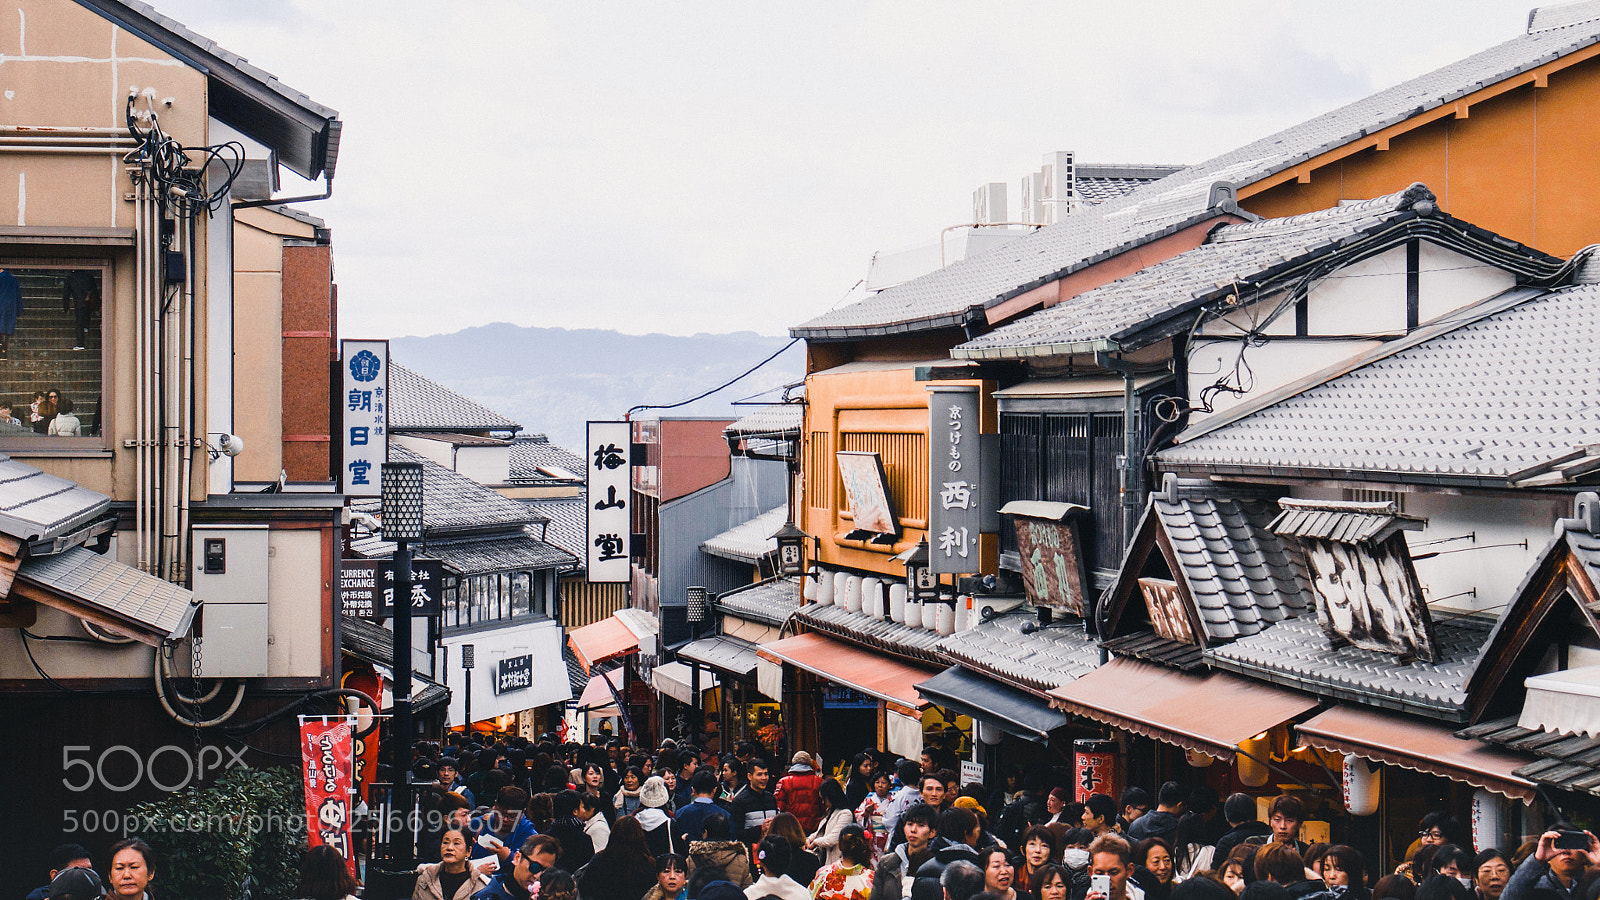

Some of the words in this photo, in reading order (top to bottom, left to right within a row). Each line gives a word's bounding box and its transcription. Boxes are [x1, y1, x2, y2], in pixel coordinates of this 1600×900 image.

[348, 388, 372, 486] 朝日堂
[948, 404, 962, 472] 京つけもの
[939, 480, 970, 558] 西利
[341, 569, 376, 579] CURRENCY
[341, 579, 376, 588] EXCHANGE
[383, 569, 430, 581] 有会社
